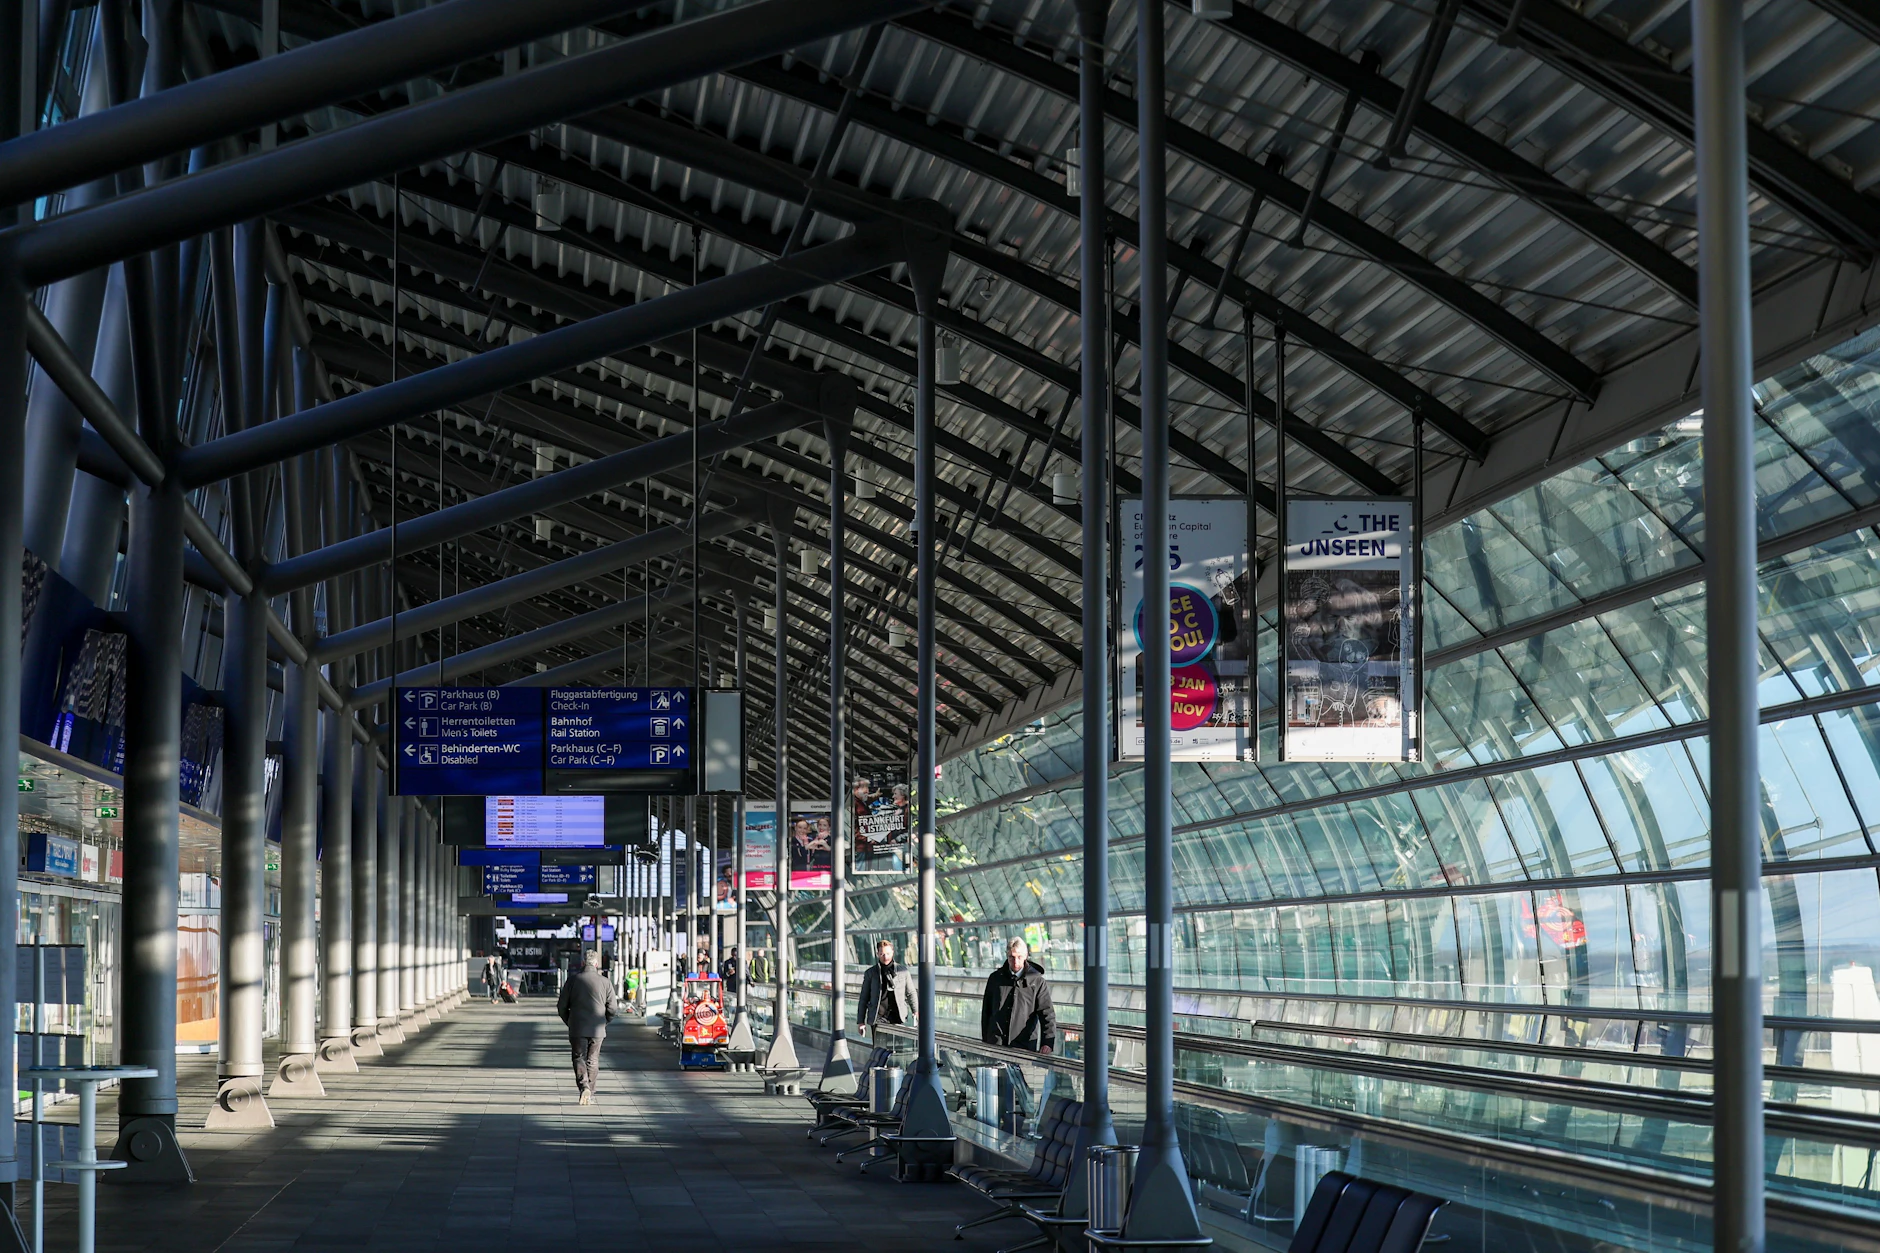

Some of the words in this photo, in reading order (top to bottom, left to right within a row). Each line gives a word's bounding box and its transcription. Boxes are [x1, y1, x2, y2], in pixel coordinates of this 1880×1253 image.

[1179, 522, 1212, 532] Capital
[1170, 629, 1205, 652] OU!
[1178, 677, 1206, 691] JAN
[441, 690, 484, 699] Parkhaus
[486, 690, 500, 700] (B)
[551, 690, 638, 701] Fluggastabfertigung
[441, 701, 456, 710] Car
[459, 701, 478, 710] Park
[480, 701, 492, 711] (B)
[551, 701, 590, 710] Check-In
[1173, 702, 1206, 717] NOV
[441, 717, 516, 726] Herrentoiletten
[551, 717, 592, 726] Bahnhof
[470, 728, 498, 737] Toilets
[551, 728, 566, 737] Rail
[569, 728, 600, 737] Station
[441, 744, 521, 753] Behinderten-WC
[551, 744, 594, 753] Parkhaus
[441, 755, 478, 764] Disabled
[551, 755, 566, 764] Car
[568, 755, 588, 764] Park
[858, 815, 905, 826] FRANKFURT
[867, 822, 906, 833] ISTANBUL
